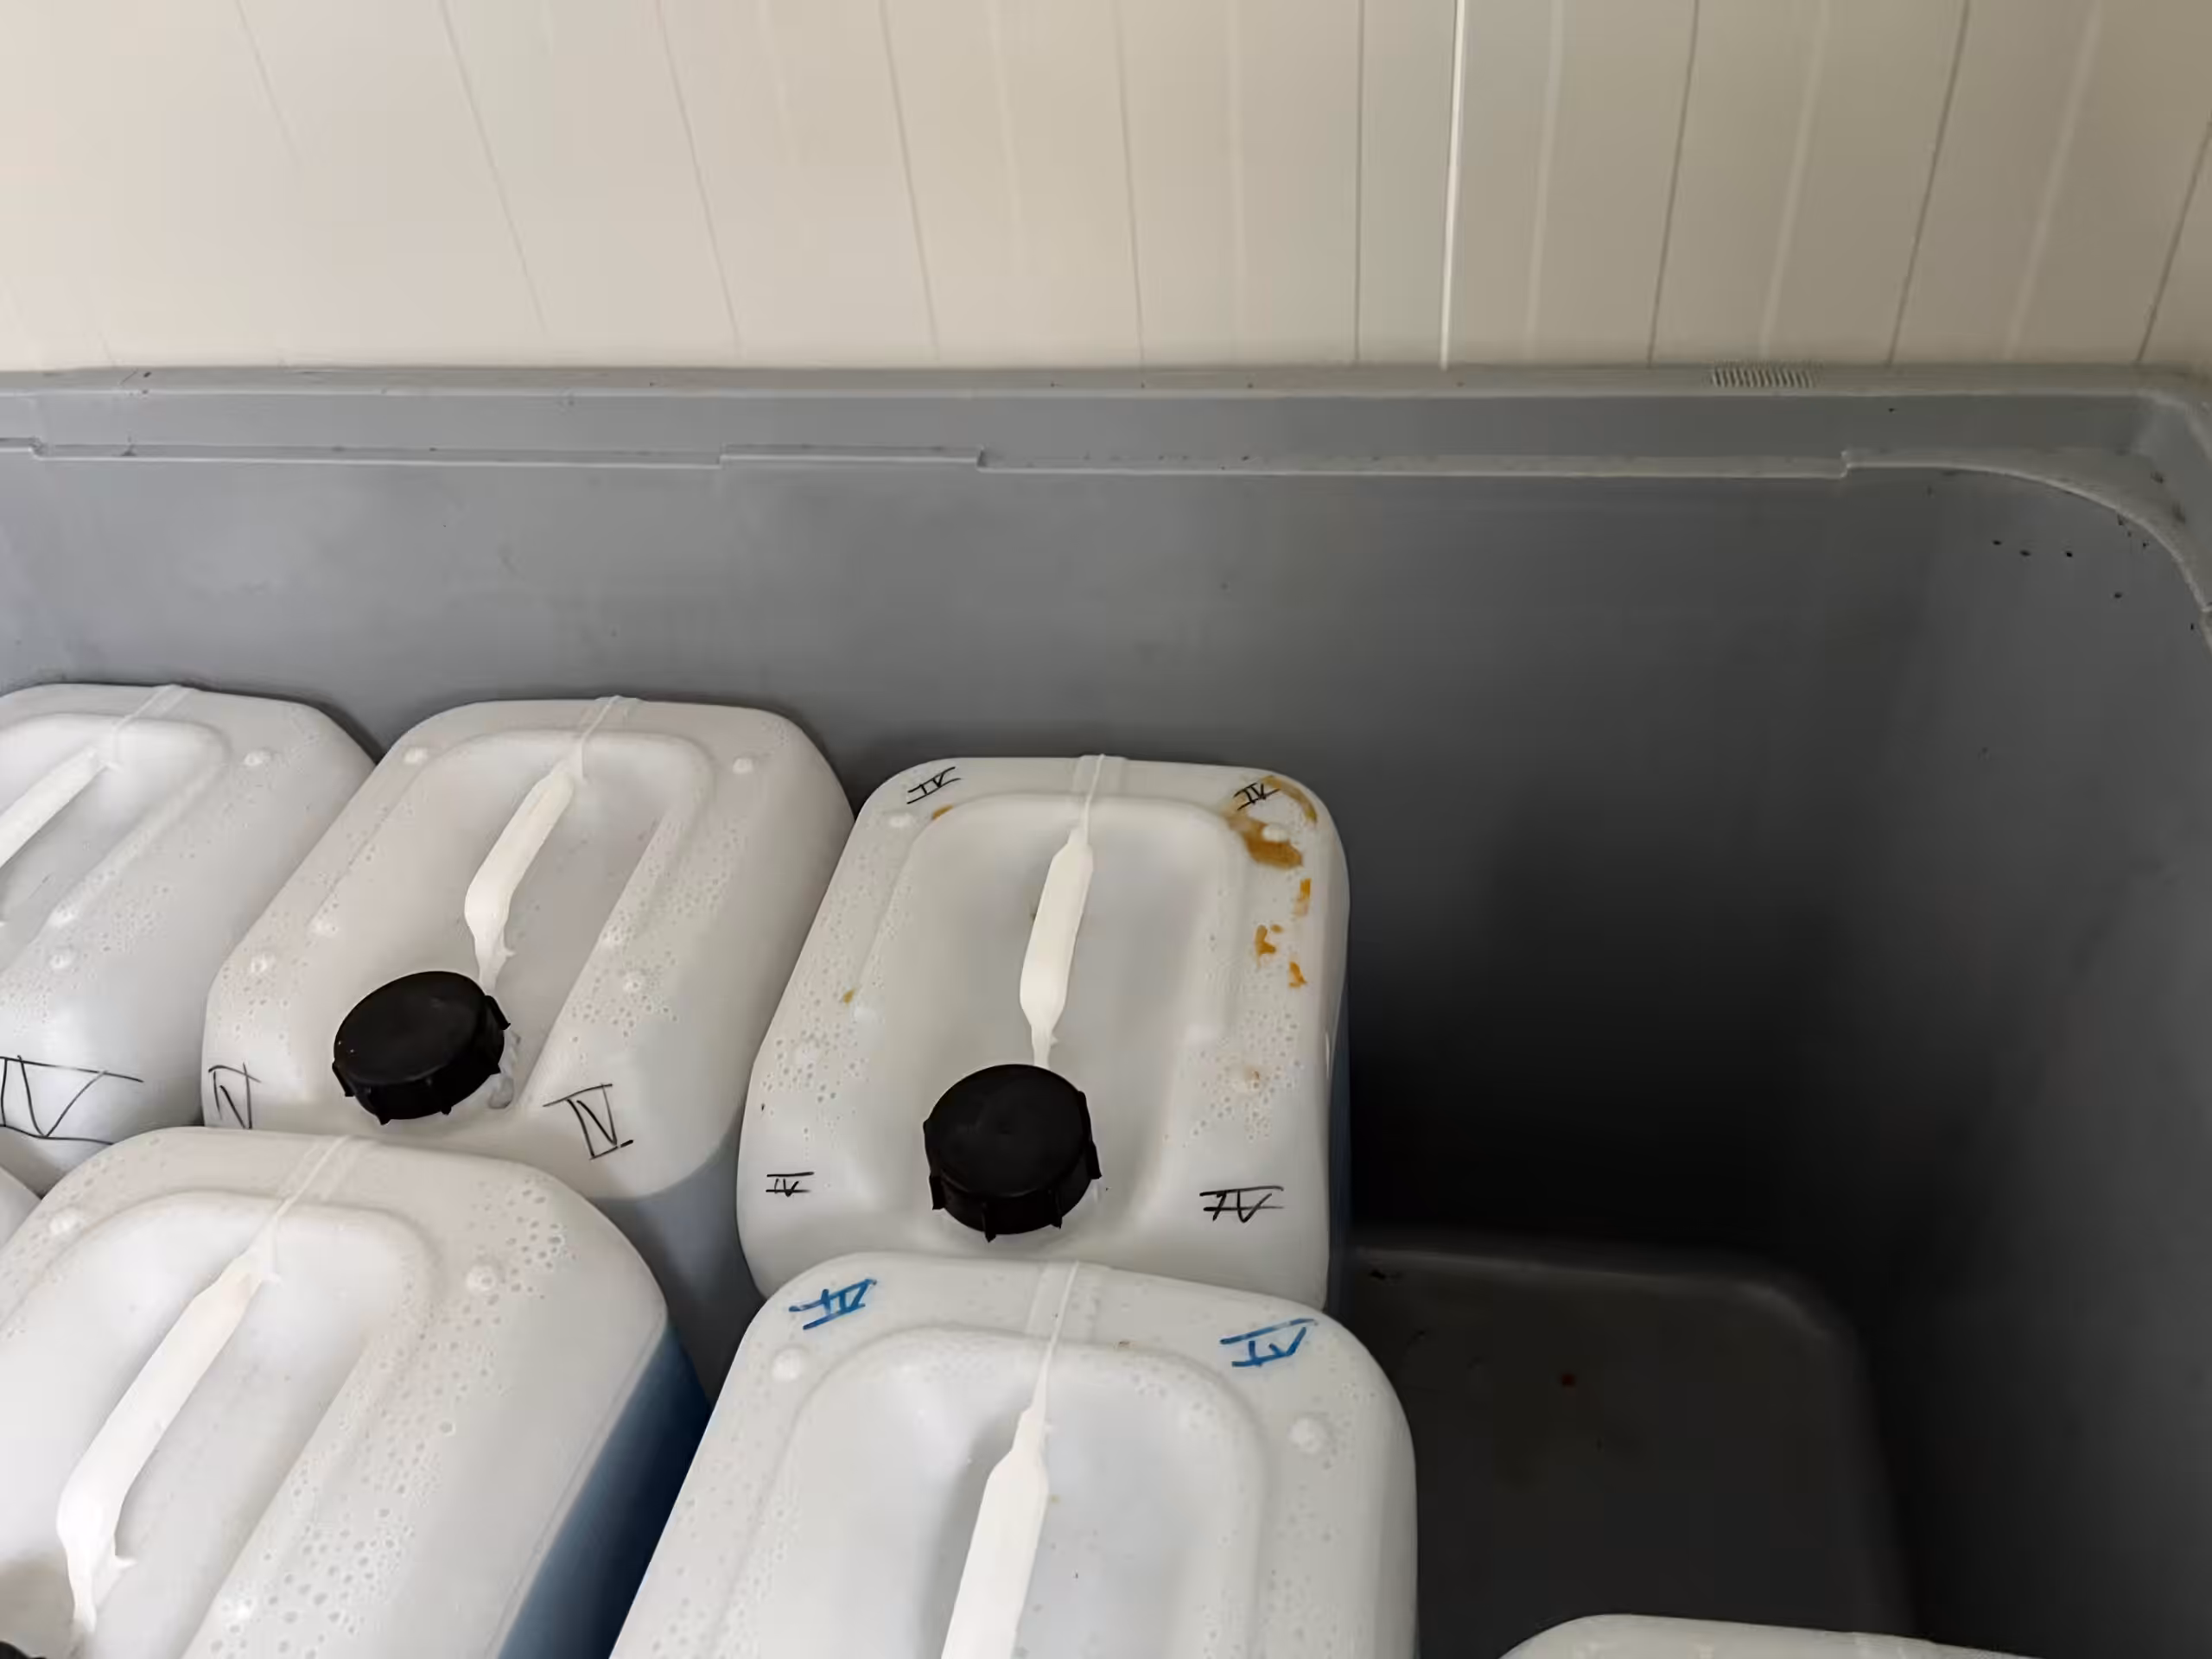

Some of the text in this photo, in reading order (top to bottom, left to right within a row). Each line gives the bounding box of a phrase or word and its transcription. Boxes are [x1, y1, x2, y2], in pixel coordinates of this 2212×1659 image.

[906, 766, 962, 804] IV
[1234, 782, 1281, 810] IV
[766, 1172, 814, 1197] IV
[1199, 1185, 1284, 1223] IV
[789, 1278, 877, 1330] IV
[1220, 1318, 1318, 1367] IV
